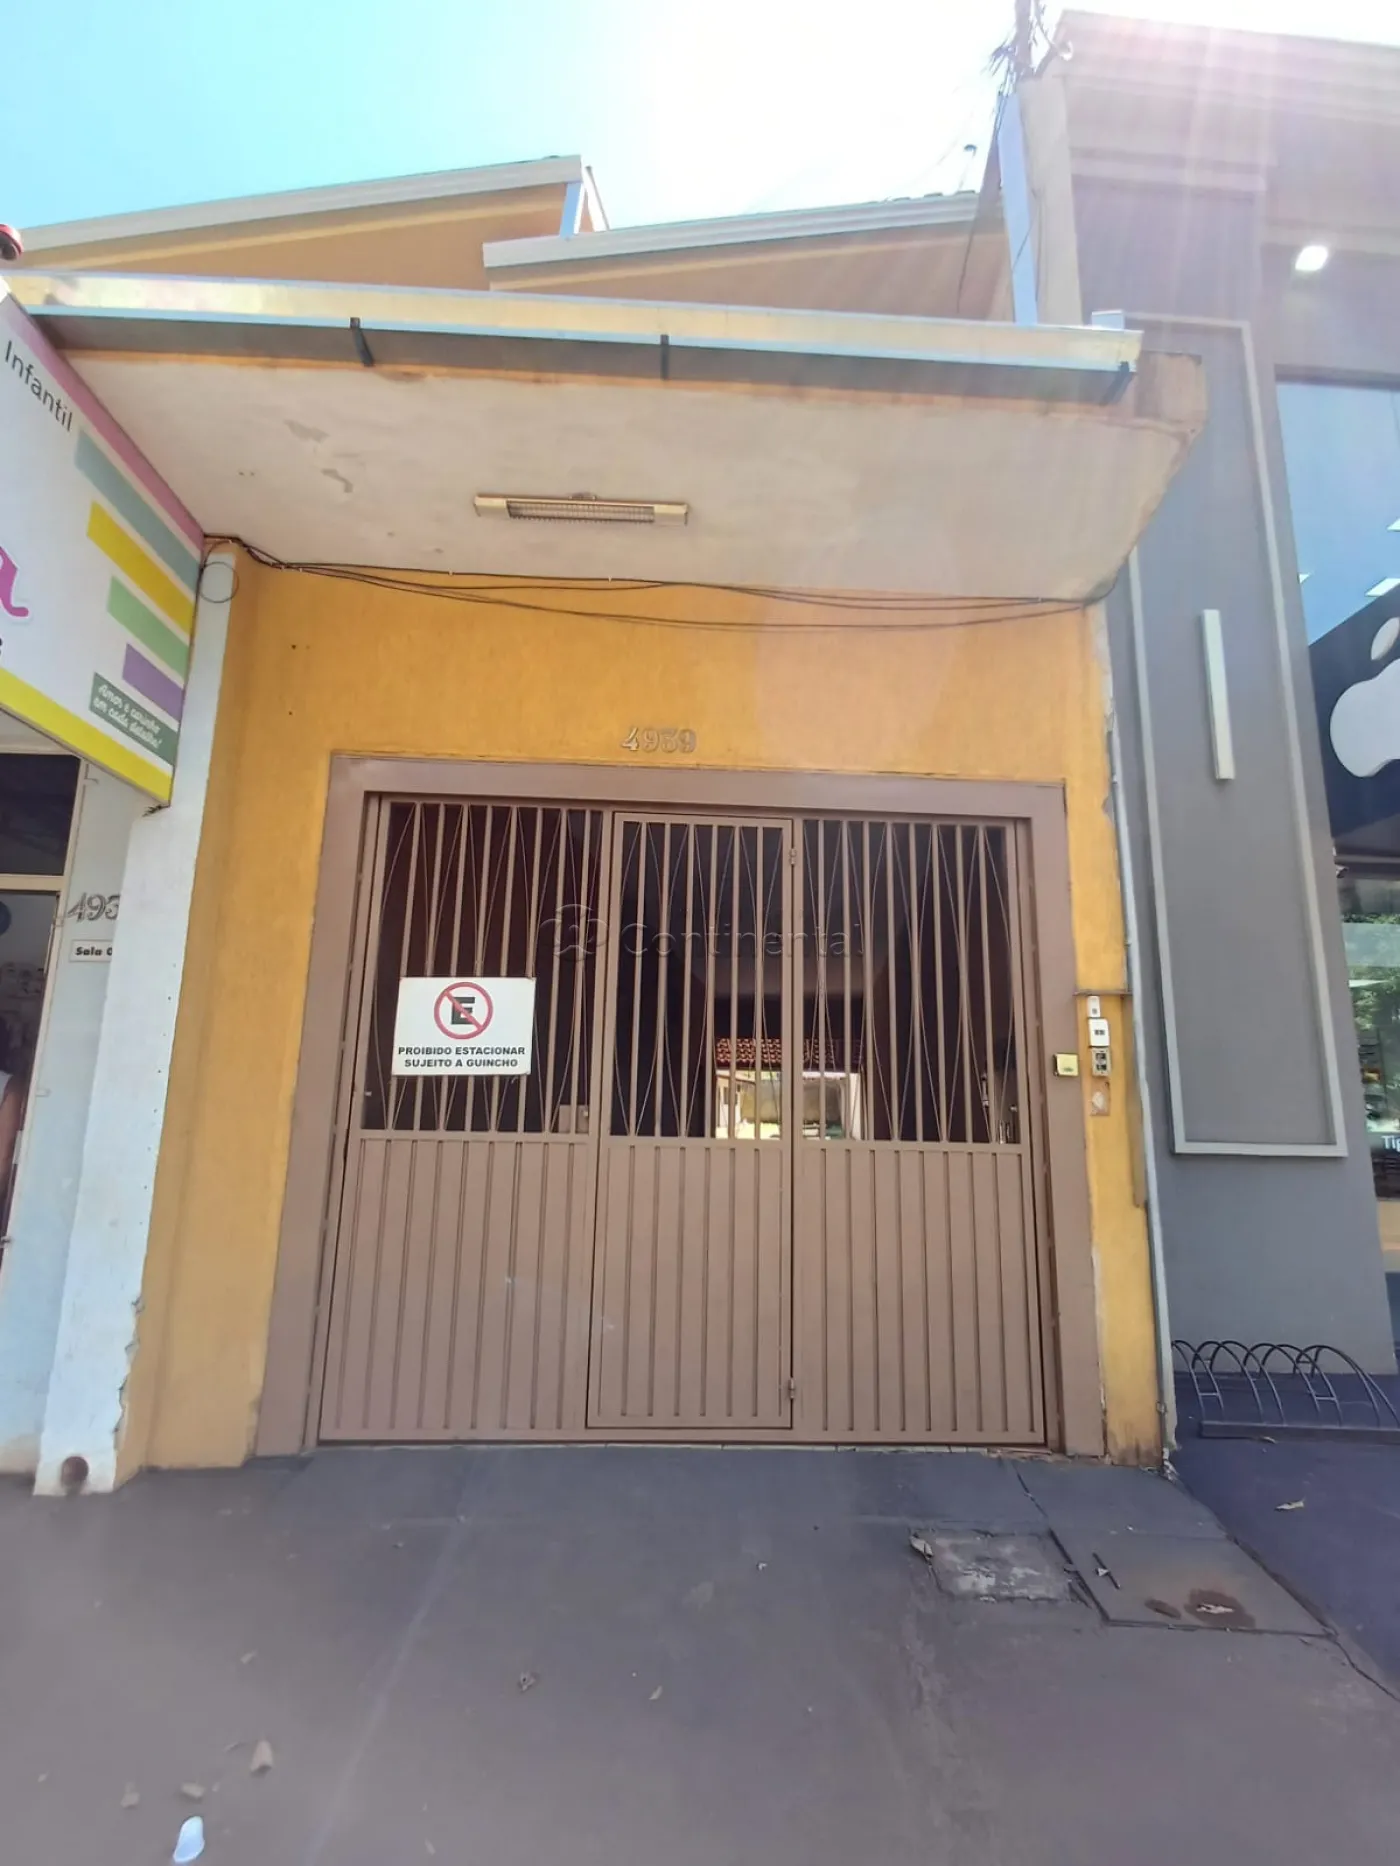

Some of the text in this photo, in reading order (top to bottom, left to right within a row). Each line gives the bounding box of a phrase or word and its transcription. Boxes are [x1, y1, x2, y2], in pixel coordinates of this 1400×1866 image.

[5, 340, 73, 432] Infantil
[75, 946, 103, 956] Sala
[398, 1046, 526, 1056] PROIBIDO ESTACIONAR
[404, 1058, 519, 1068] SUJEITO A GUINCHO
